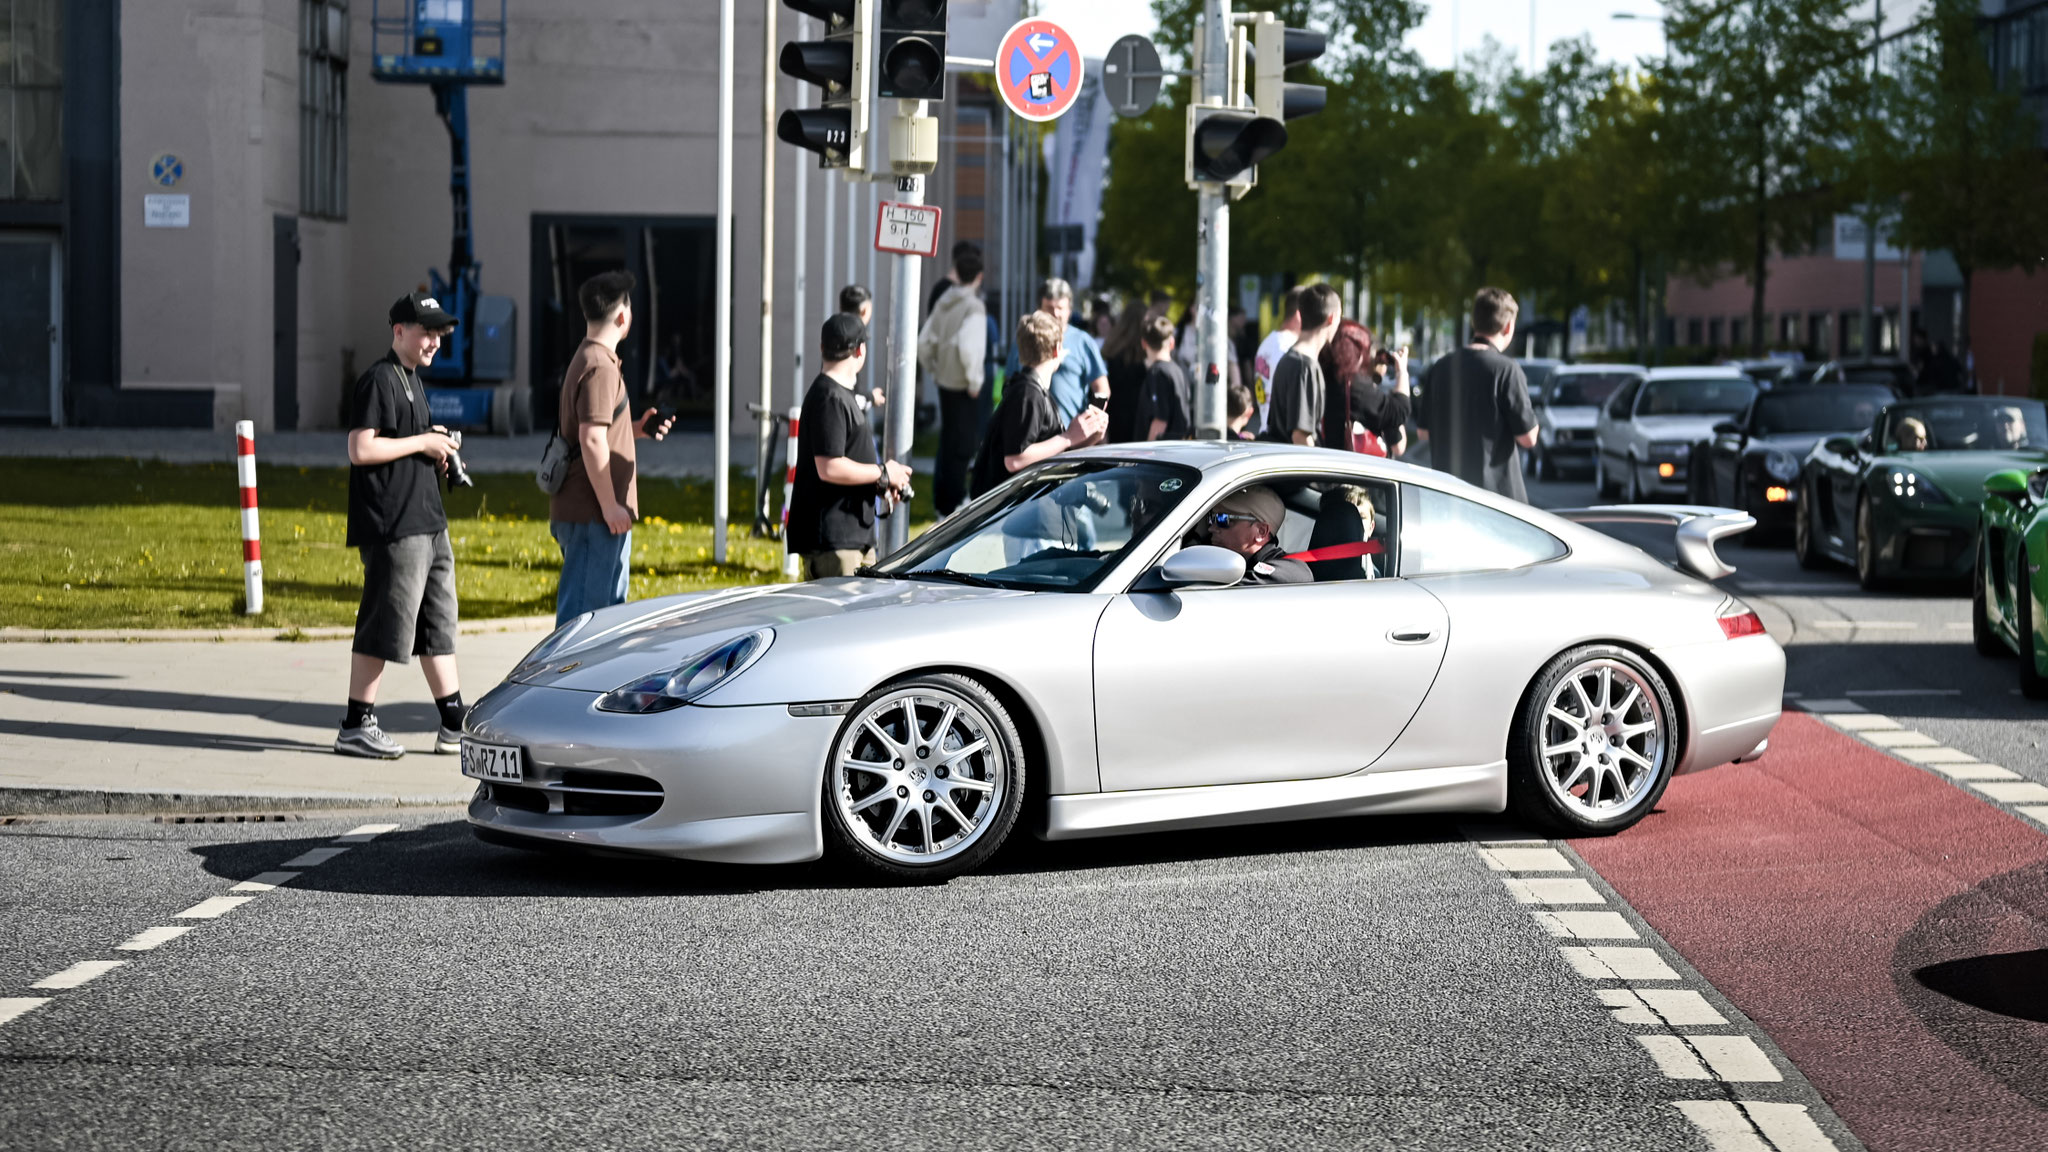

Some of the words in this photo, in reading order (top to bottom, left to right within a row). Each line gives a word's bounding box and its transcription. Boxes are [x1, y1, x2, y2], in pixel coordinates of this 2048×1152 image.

[886, 206, 895, 219] H
[903, 208, 924, 223] 150
[480, 748, 499, 777] RZ
[500, 750, 521, 779] 11
